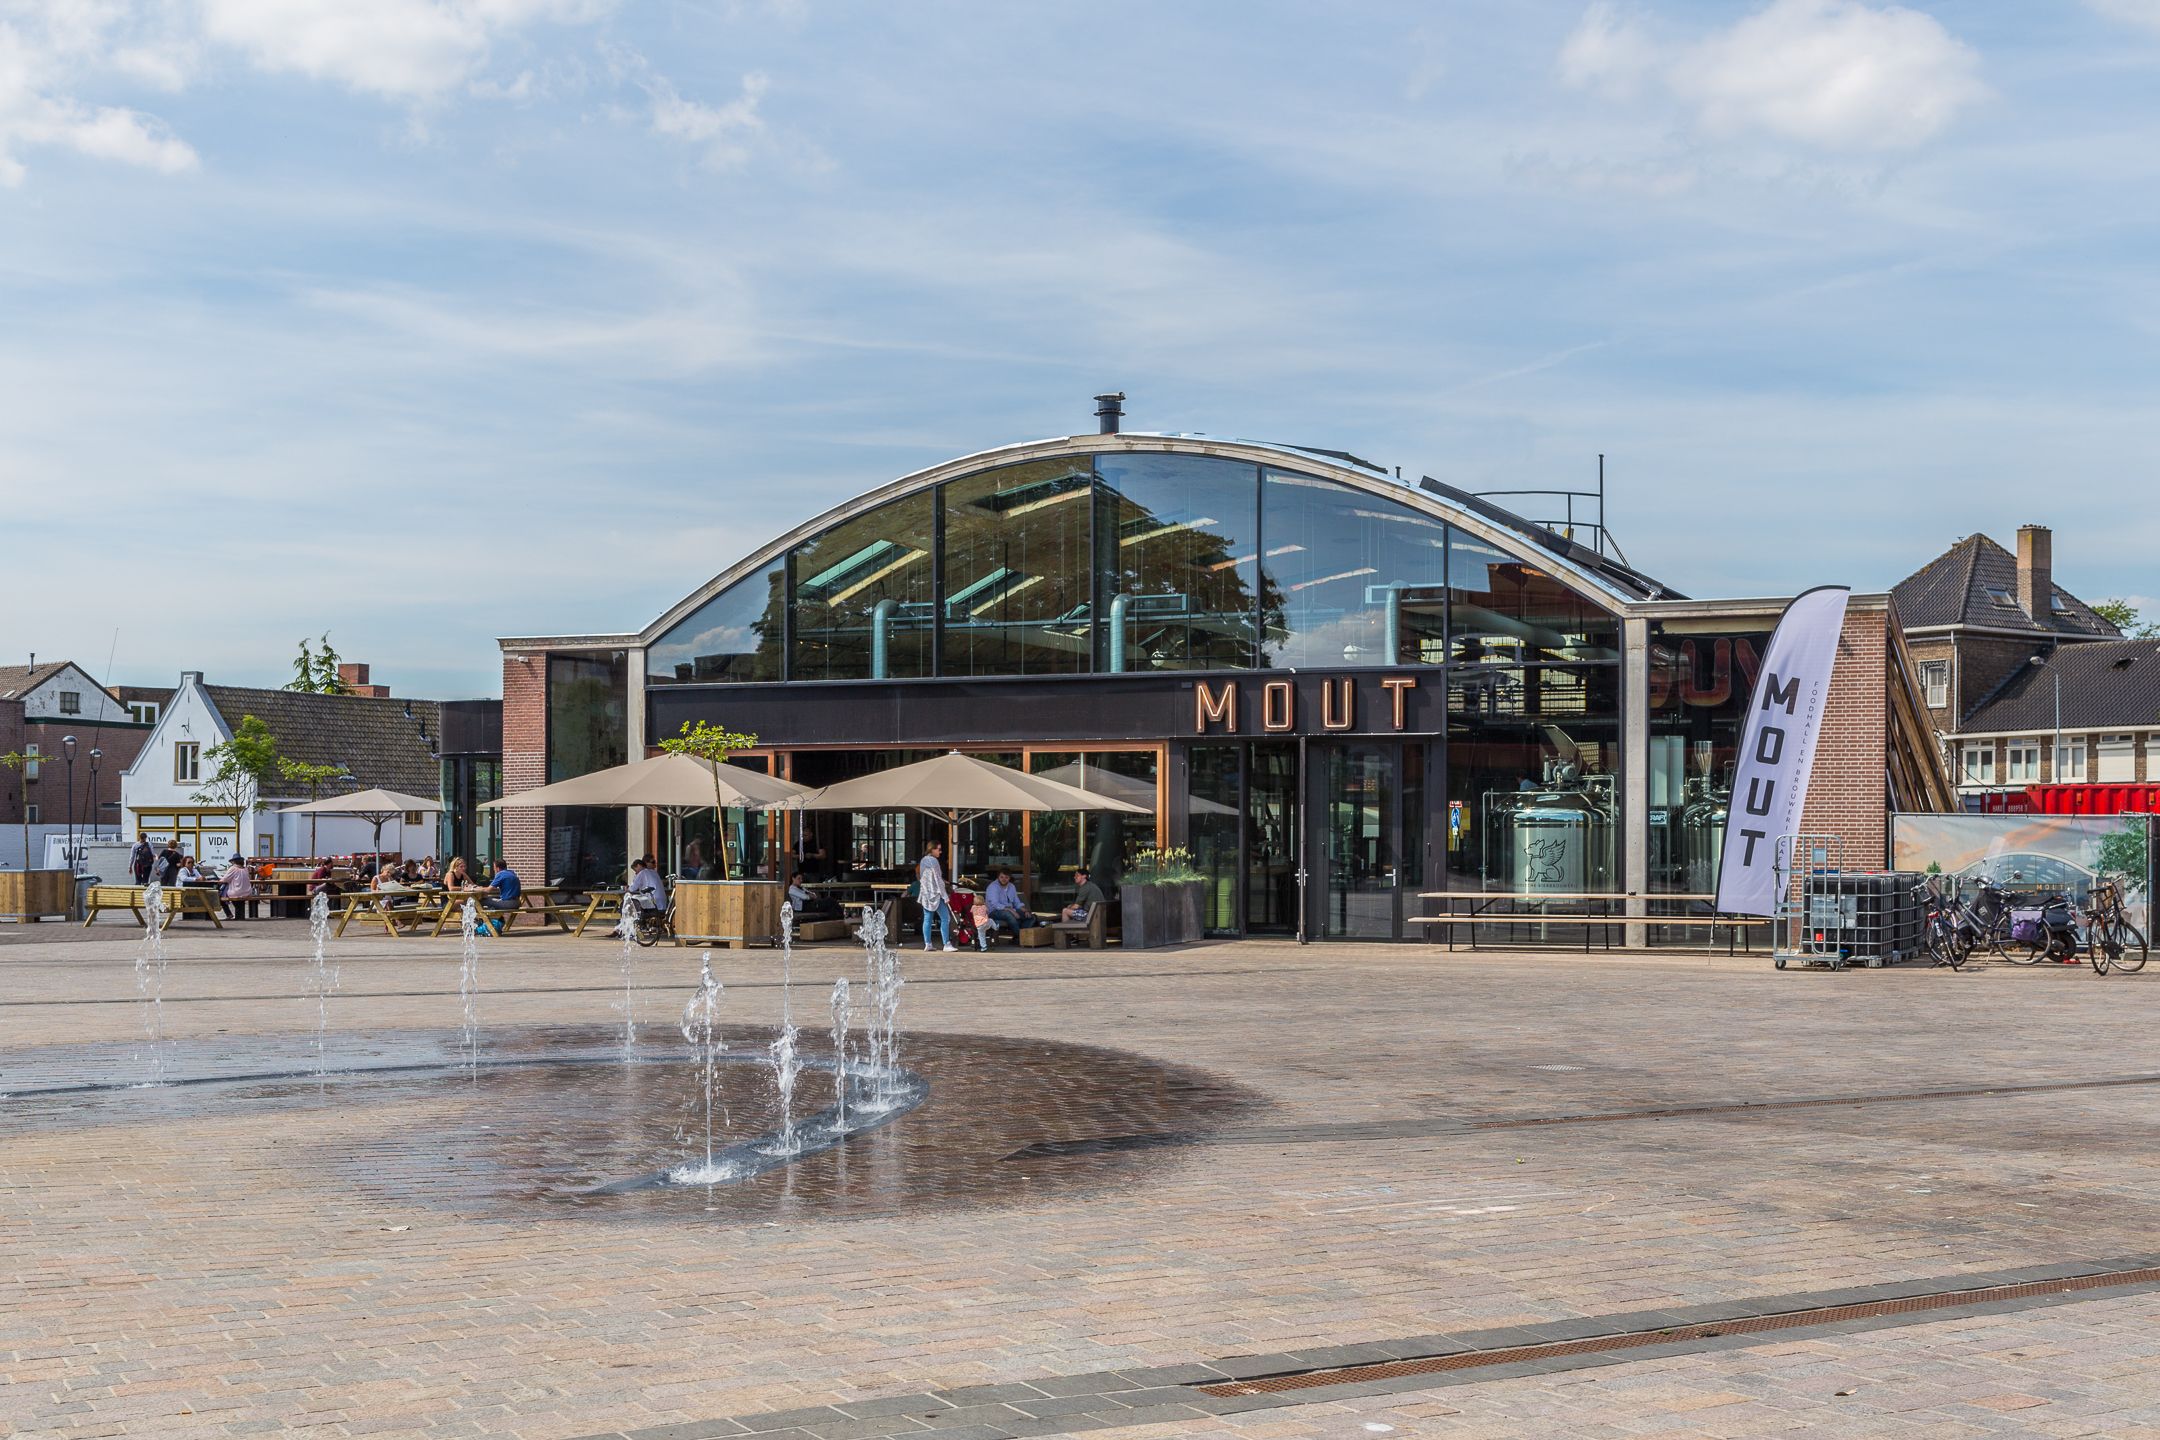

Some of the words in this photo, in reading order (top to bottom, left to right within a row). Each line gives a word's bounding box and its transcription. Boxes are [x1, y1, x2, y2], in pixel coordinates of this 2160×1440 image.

[1195, 677, 1417, 732] MOUT
[1803, 681, 1819, 745] FOODHALL
[1740, 673, 1800, 866] MOUT
[1798, 749, 1805, 764] EN
[1784, 769, 1801, 838] BROUWERI
[62, 846, 88, 861] VID
[208, 837, 228, 846] VIDA
